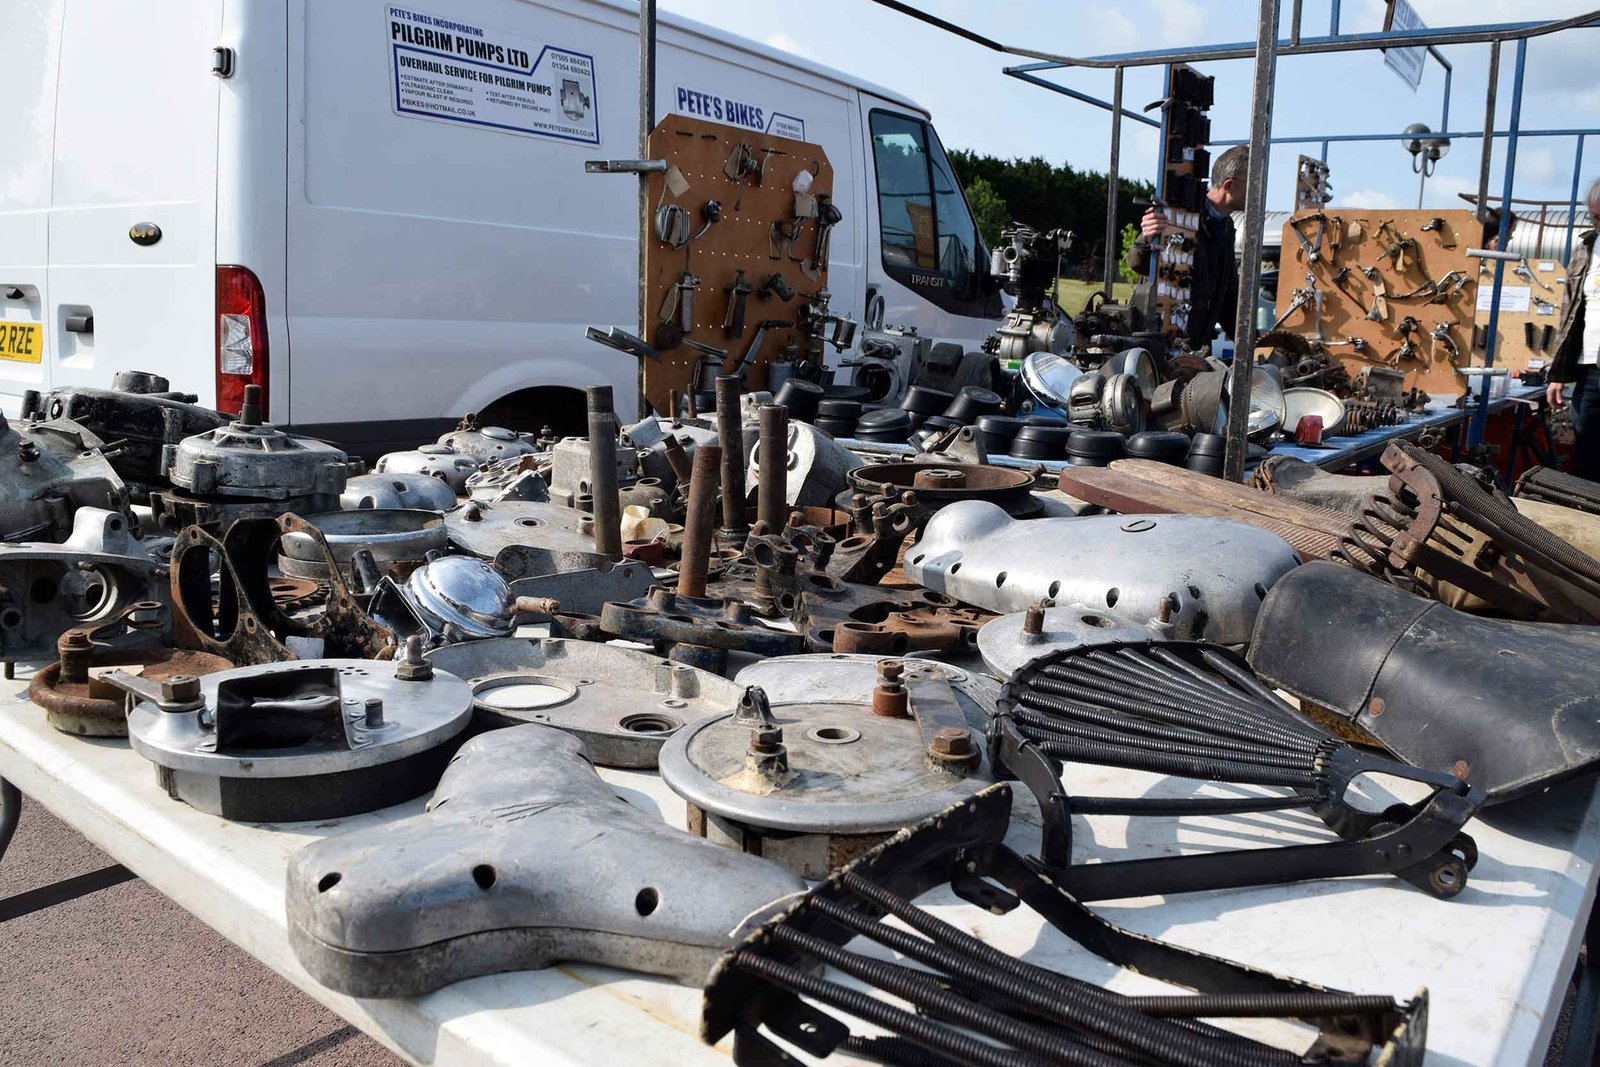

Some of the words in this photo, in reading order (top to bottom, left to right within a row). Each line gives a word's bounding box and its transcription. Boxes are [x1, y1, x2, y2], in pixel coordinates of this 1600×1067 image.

[390, 8, 411, 20] PETE'S
[412, 13, 432, 25] BIKES
[433, 18, 484, 37] INCORPORATING
[391, 21, 453, 52] PILGRIM
[456, 36, 504, 63] PUMPS
[507, 48, 529, 68] LTD
[400, 56, 443, 74] OVERHAUL
[444, 65, 478, 81] SERVICE
[479, 72, 493, 84] FOR
[495, 75, 525, 90] PILGRIM
[527, 82, 552, 96] PUMPS
[404, 82, 436, 92] ULTRASONIC
[437, 87, 454, 95] CLEAN
[677, 87, 722, 120] PETE'S
[725, 99, 764, 130] BIKES
[912, 274, 944, 287] TRANSIT
[8, 326, 34, 355] RZE
